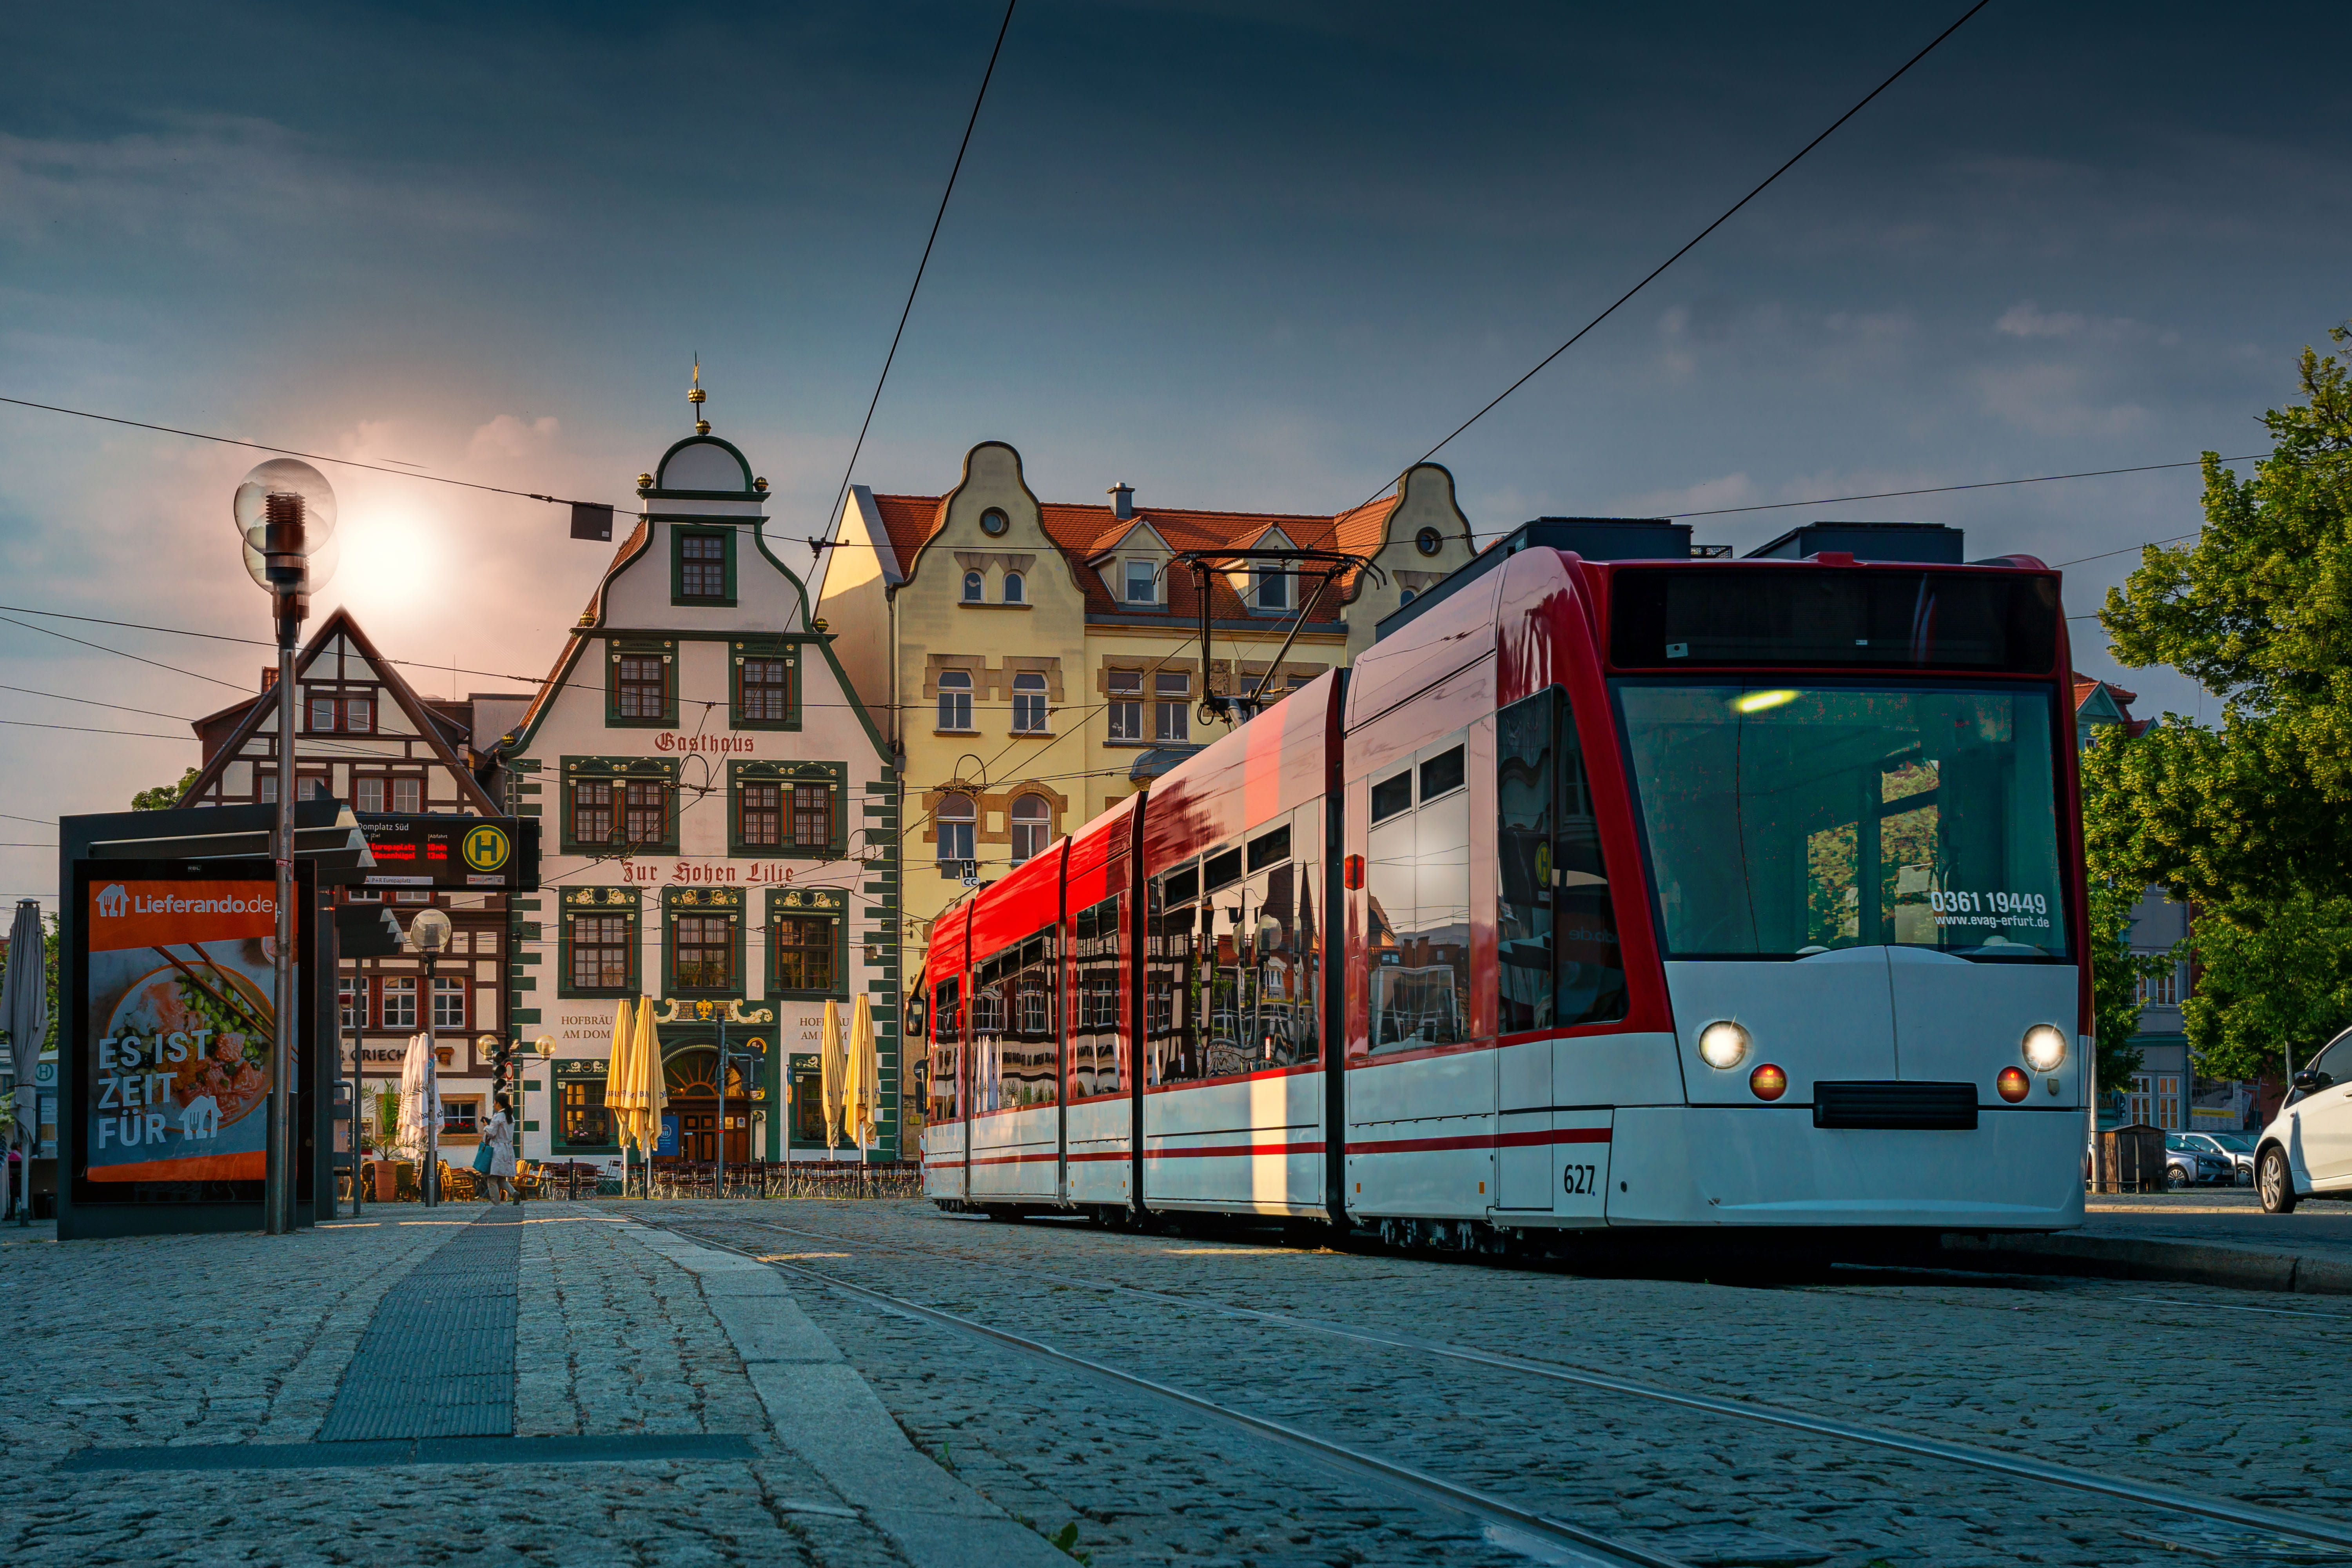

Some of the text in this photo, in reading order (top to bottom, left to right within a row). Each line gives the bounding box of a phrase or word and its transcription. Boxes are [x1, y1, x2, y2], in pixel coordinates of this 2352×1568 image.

[655, 732, 754, 755] Gasthaus
[358, 823, 392, 831] Domplatz
[475, 835, 497, 861] H
[623, 862, 794, 884] Zur Hohen Lilie
[964, 862, 975, 877] H
[135, 894, 272, 913] Lieferando.de
[1931, 891, 2046, 914] 0361 19449
[1935, 915, 2049, 928] www.evag-erfurt.de
[561, 1014, 613, 1024] HOFBRÄU
[800, 1016, 849, 1026] HOFU
[563, 1030, 610, 1038] AM DOM
[100, 1029, 212, 1069] ES IST
[39, 1066, 48, 1077] H
[98, 1072, 177, 1109] ZEIT
[98, 1109, 166, 1149] FÜR
[1564, 1164, 1595, 1194] 627
